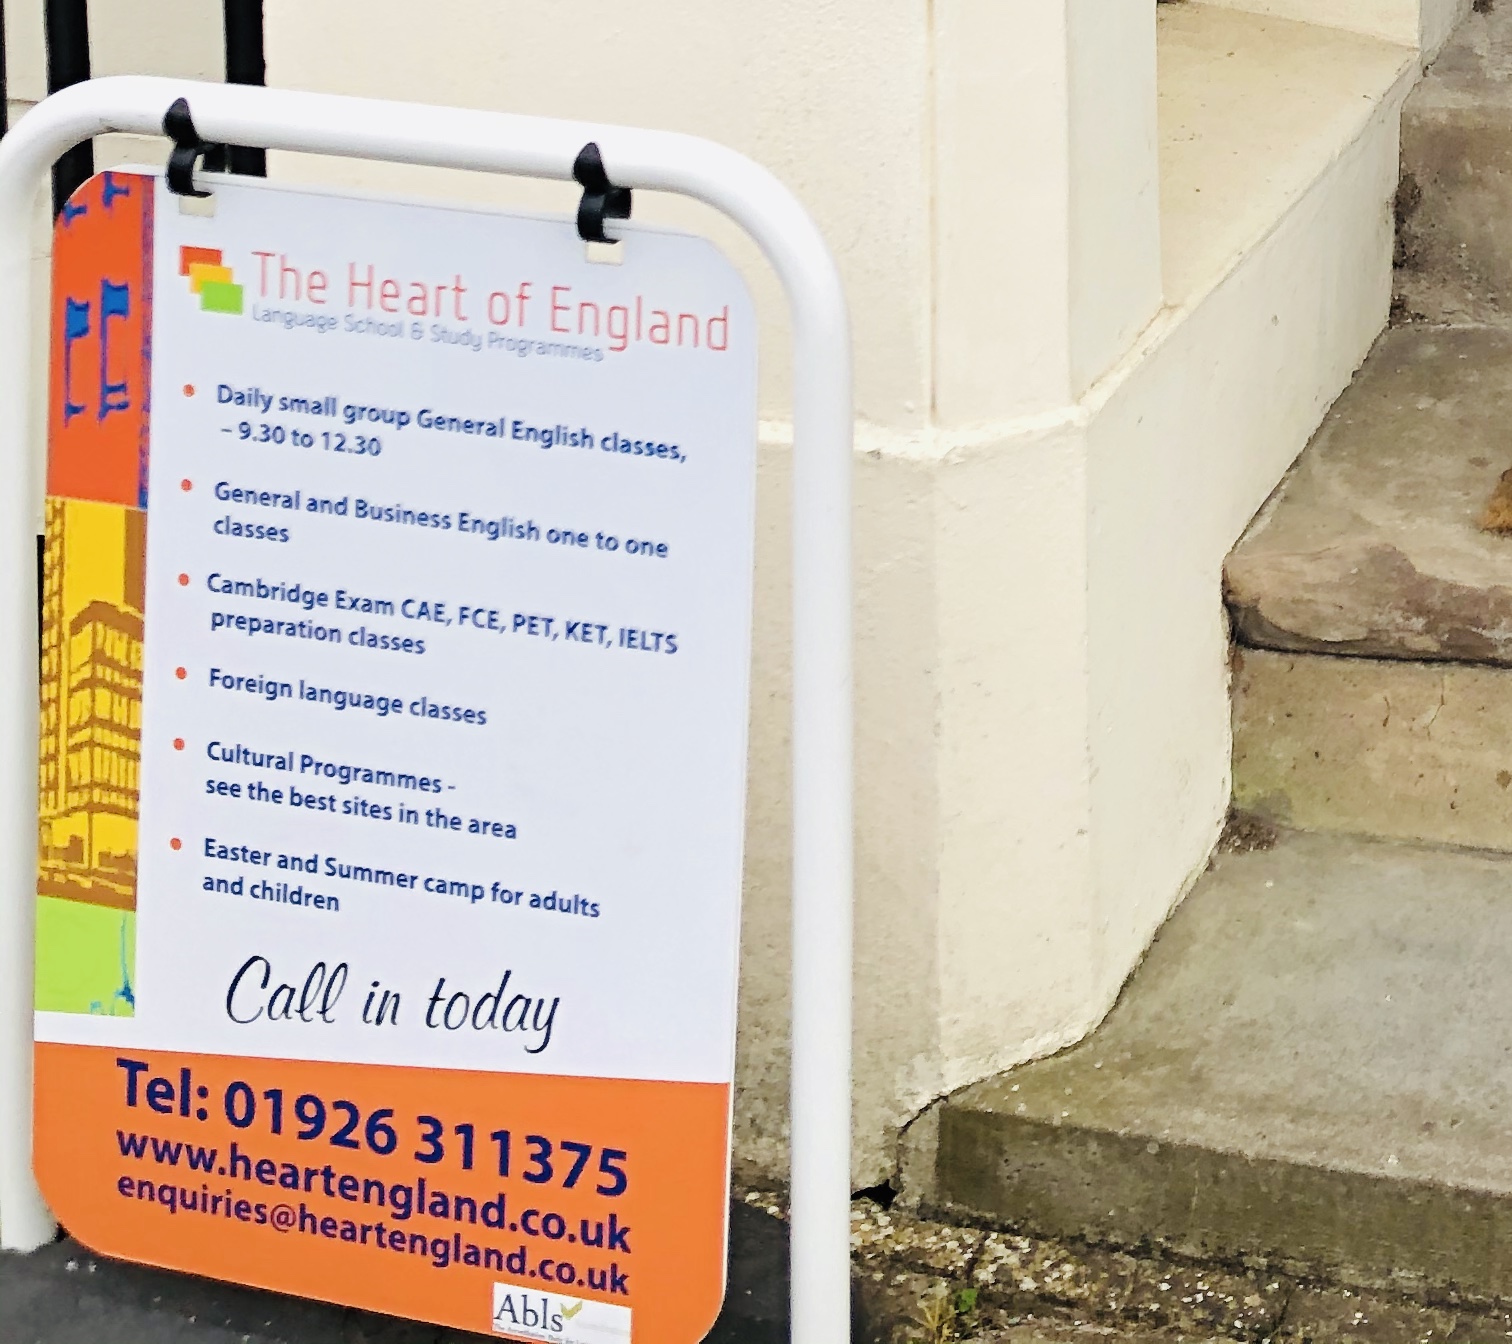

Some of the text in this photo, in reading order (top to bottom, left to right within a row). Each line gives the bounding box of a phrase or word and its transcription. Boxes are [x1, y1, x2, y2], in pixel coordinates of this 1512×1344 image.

[252, 251, 728, 352] The Heart of England
[252, 304, 603, 362] Language School & Study Programmes
[217, 384, 686, 463] Daily small group General English classes,
[238, 420, 288, 445] 9.30
[290, 428, 316, 448] to
[321, 431, 382, 456] 12.30
[214, 518, 289, 542] classes
[215, 482, 668, 558] General and Business English one to one
[207, 573, 677, 654] Cambridge Exam CAE, FCE, PET, KET, IELTS
[211, 612, 426, 654] preparation classes
[209, 669, 487, 725] Foreign language classes
[207, 741, 294, 772] Cultural
[300, 754, 443, 794] Programmes
[206, 780, 516, 839] see the best sites in the area
[203, 876, 339, 912] and children
[204, 838, 600, 917] Easter and Summer camp for adults
[226, 956, 560, 1054] Call in today
[117, 1058, 628, 1196] Tel: 01926 311375
[117, 1130, 630, 1253] www.heartengland.co.uk
[118, 1177, 628, 1295] enquiries@heartengland.co.uk
[493, 1293, 563, 1332] Abls
